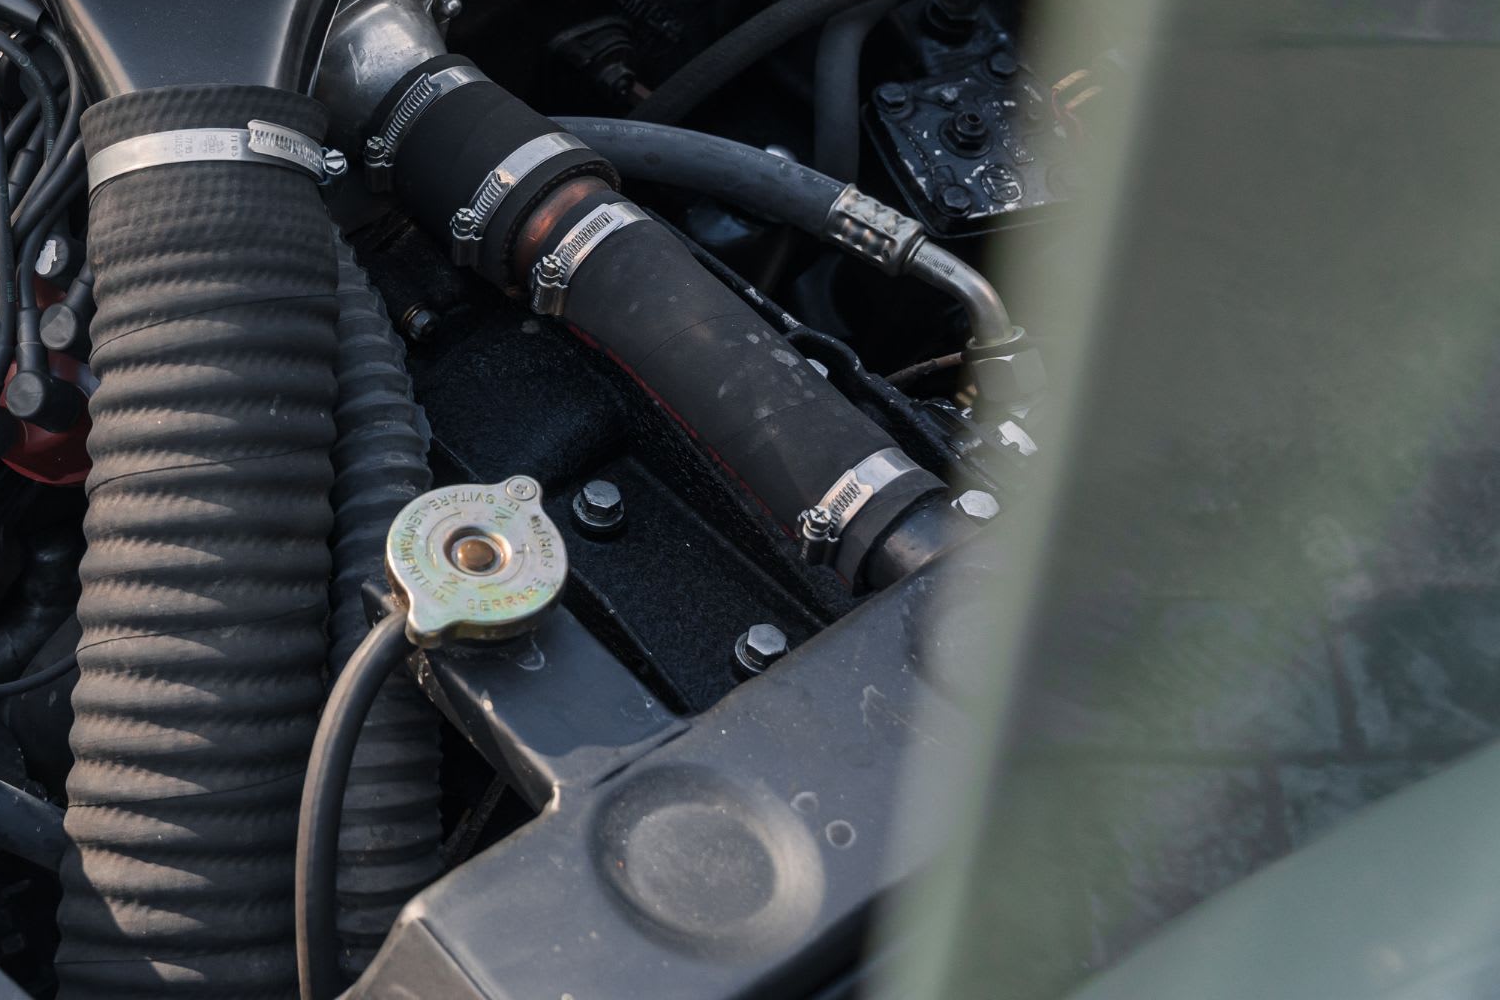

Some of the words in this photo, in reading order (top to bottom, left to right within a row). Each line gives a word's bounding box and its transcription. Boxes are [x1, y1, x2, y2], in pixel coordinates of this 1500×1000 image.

[428, 493, 495, 511] SVITARE
[400, 508, 432, 588] LENTAMENTE
[467, 577, 547, 612] SERRARE
